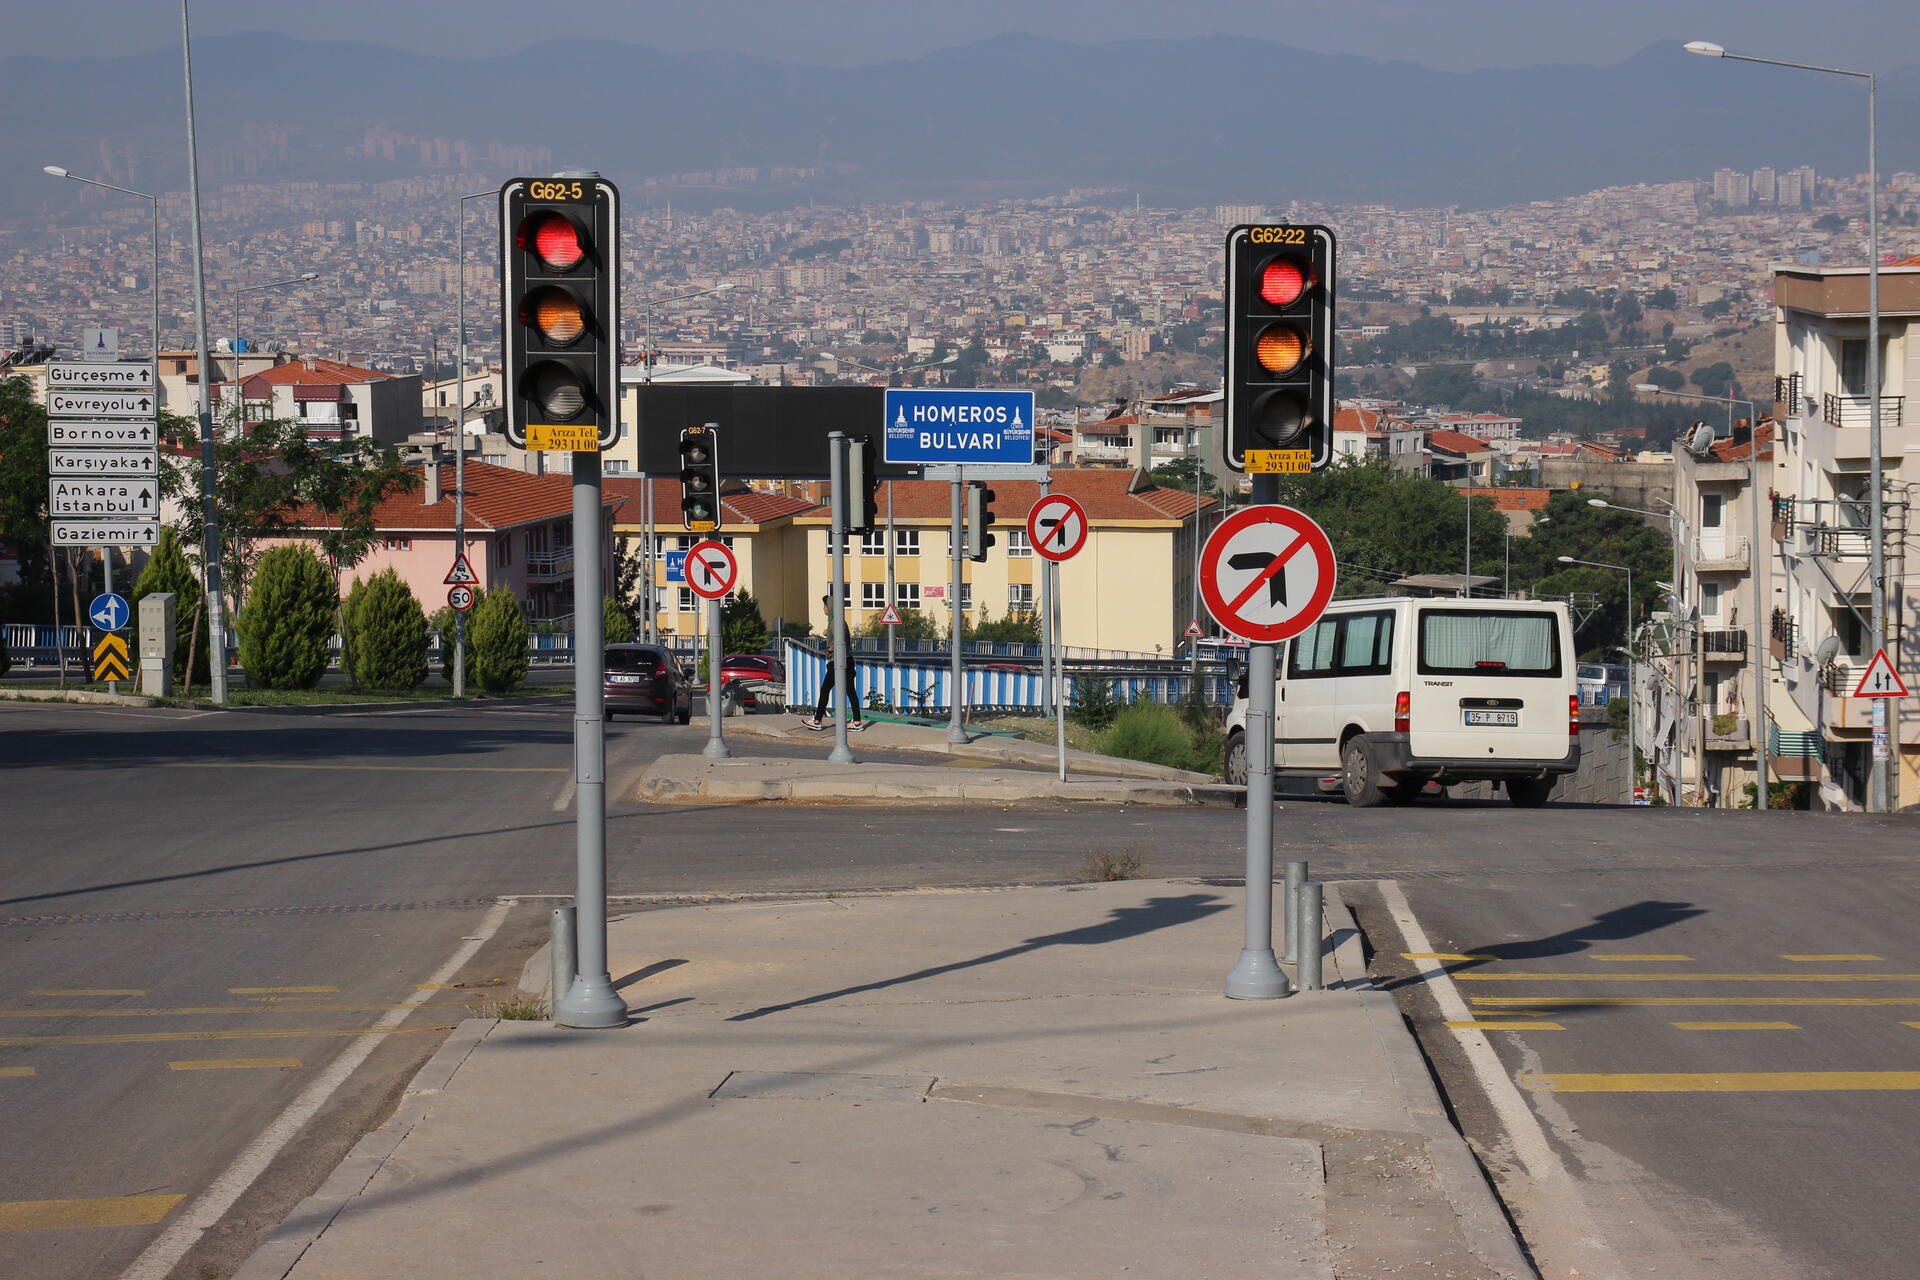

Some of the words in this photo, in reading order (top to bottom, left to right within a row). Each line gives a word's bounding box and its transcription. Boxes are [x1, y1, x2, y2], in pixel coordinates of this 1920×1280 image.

[530, 181, 582, 200] G62-5
[1251, 227, 1305, 245] G62-22
[51, 368, 135, 382] Gürçeşme
[54, 397, 135, 413] Çevreyolu
[914, 405, 1007, 423] HOMEROS
[53, 427, 136, 440] Bornova
[550, 428, 576, 437] Arıza
[578, 428, 595, 437] Tel.
[548, 439, 568, 450] 293
[920, 432, 1001, 450] BULVARI
[1266, 452, 1291, 460] Arıza
[1293, 452, 1309, 460] Tel.
[55, 456, 138, 471] Karşıyaka
[1265, 462, 1283, 471] 293
[57, 483, 128, 497] Ankara
[56, 496, 135, 512] İstanbul
[57, 527, 139, 540] Gaziemir
[452, 592, 470, 604] 50
[1486, 714, 1491, 722] P
